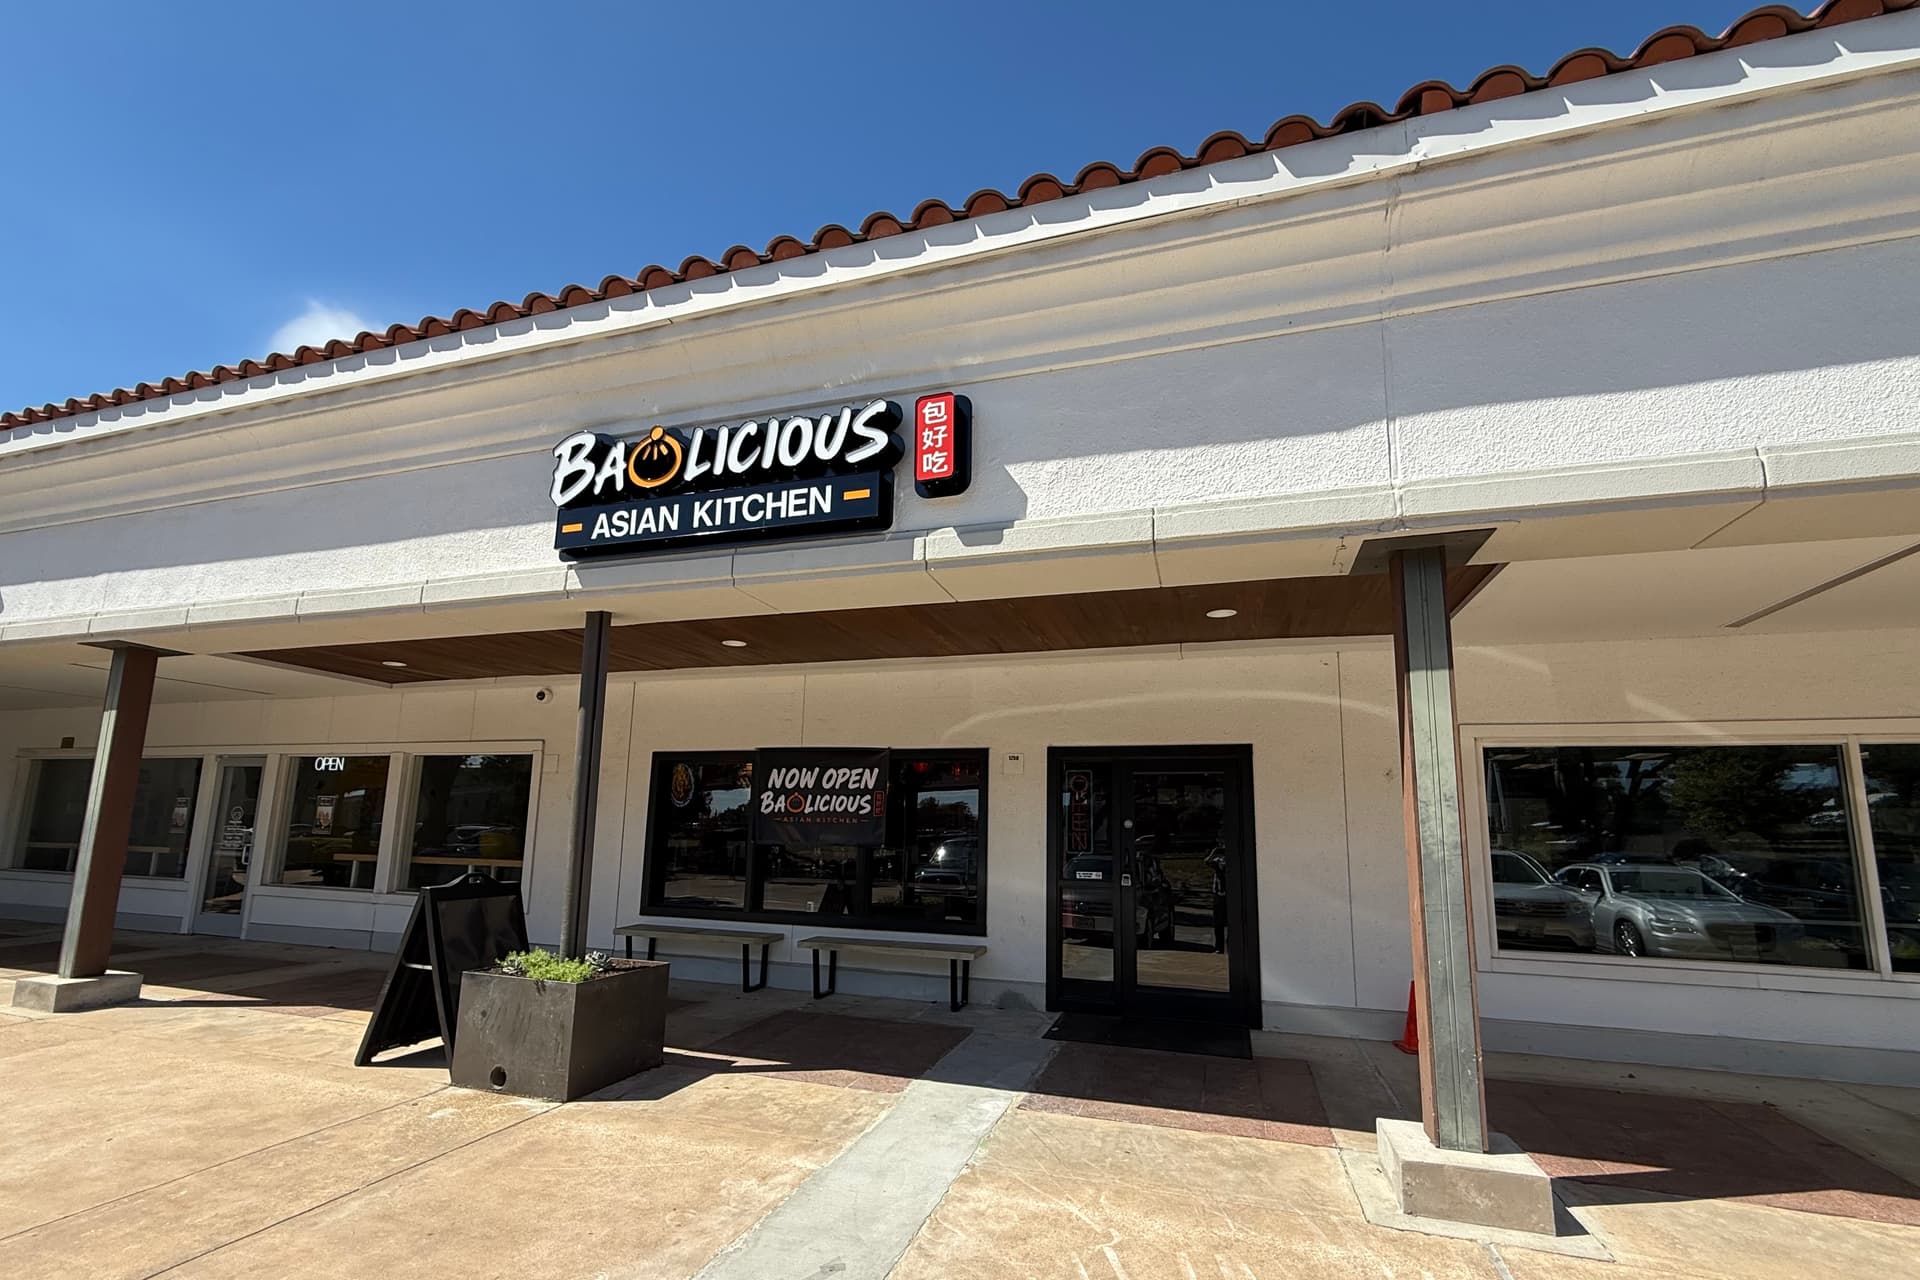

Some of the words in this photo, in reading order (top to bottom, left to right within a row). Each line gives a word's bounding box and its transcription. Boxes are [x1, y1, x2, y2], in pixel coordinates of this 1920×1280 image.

[551, 399, 888, 507] BAOLICIOUS
[922, 401, 948, 473] 包好吃
[591, 504, 679, 540] ASIAN
[692, 485, 832, 529] KITCHEN
[315, 757, 345, 771] OPEN
[767, 766, 820, 789] NOW
[821, 767, 879, 789] OPEN
[760, 790, 872, 815] BAOLICIOUS
